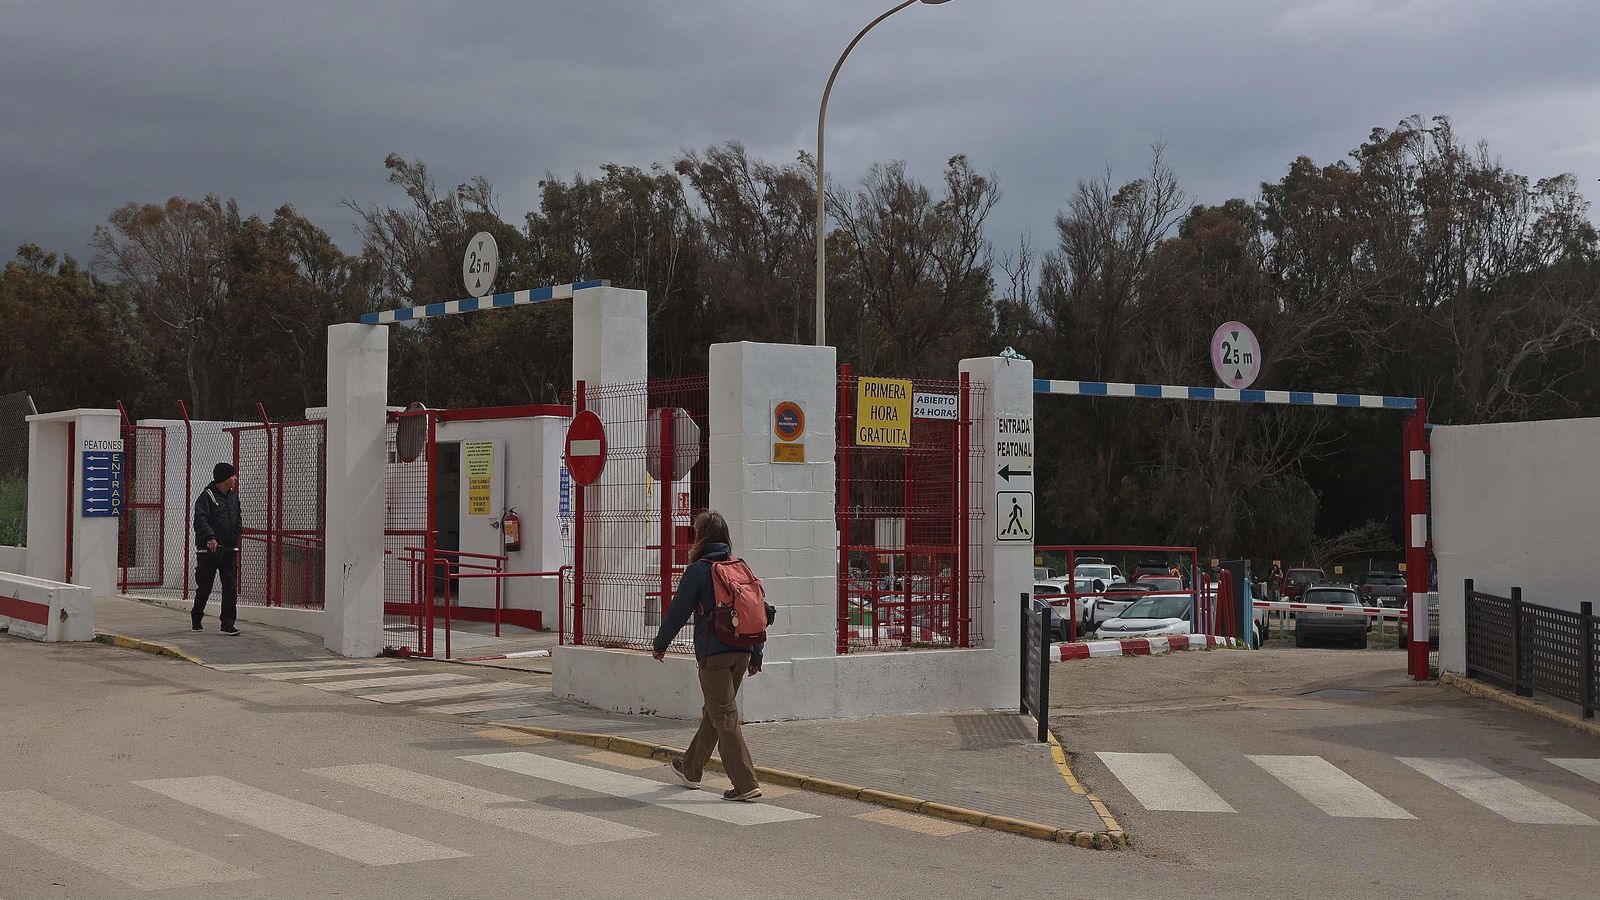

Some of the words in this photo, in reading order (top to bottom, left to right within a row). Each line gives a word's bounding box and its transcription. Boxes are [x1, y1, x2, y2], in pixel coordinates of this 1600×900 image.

[483, 262, 490, 273] m
[1243, 352, 1253, 364] m
[865, 382, 906, 400] PRIMERA
[917, 396, 955, 405] ABIERTO
[871, 405, 898, 421] HORA
[915, 407, 925, 416] 24
[928, 408, 957, 418] HORAS
[999, 418, 1030, 434] ENTRADA
[860, 426, 908, 444] GRATUITA
[84, 440, 122, 450] PEATONES
[998, 442, 1032, 457] PEATONAL
[111, 453, 121, 515] ENTRADA
